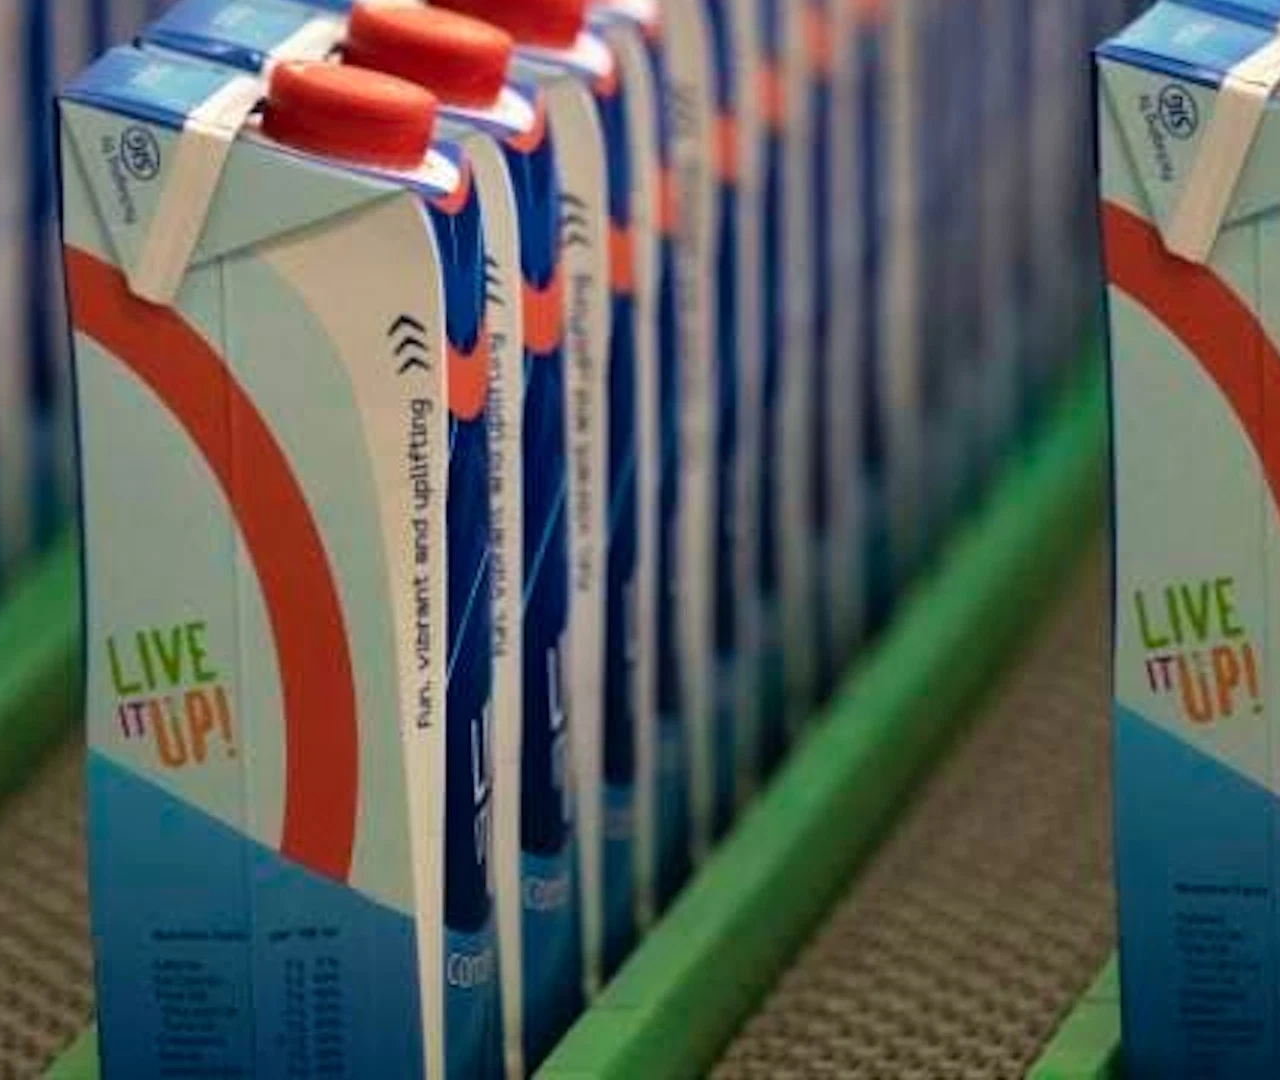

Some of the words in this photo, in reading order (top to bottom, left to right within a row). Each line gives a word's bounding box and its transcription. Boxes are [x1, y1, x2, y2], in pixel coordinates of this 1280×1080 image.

[1164, 91, 1193, 133] SIG
[127, 132, 156, 174] SIG
[406, 397, 435, 512] uplifting
[410, 517, 430, 566] and
[410, 574, 431, 672] vibrant
[1134, 577, 1245, 649] LIVE
[106, 620, 218, 695] LIVE
[1145, 655, 1174, 696] IT
[1176, 640, 1266, 725] UP!
[117, 700, 146, 739] IT
[148, 684, 238, 769] UP!
